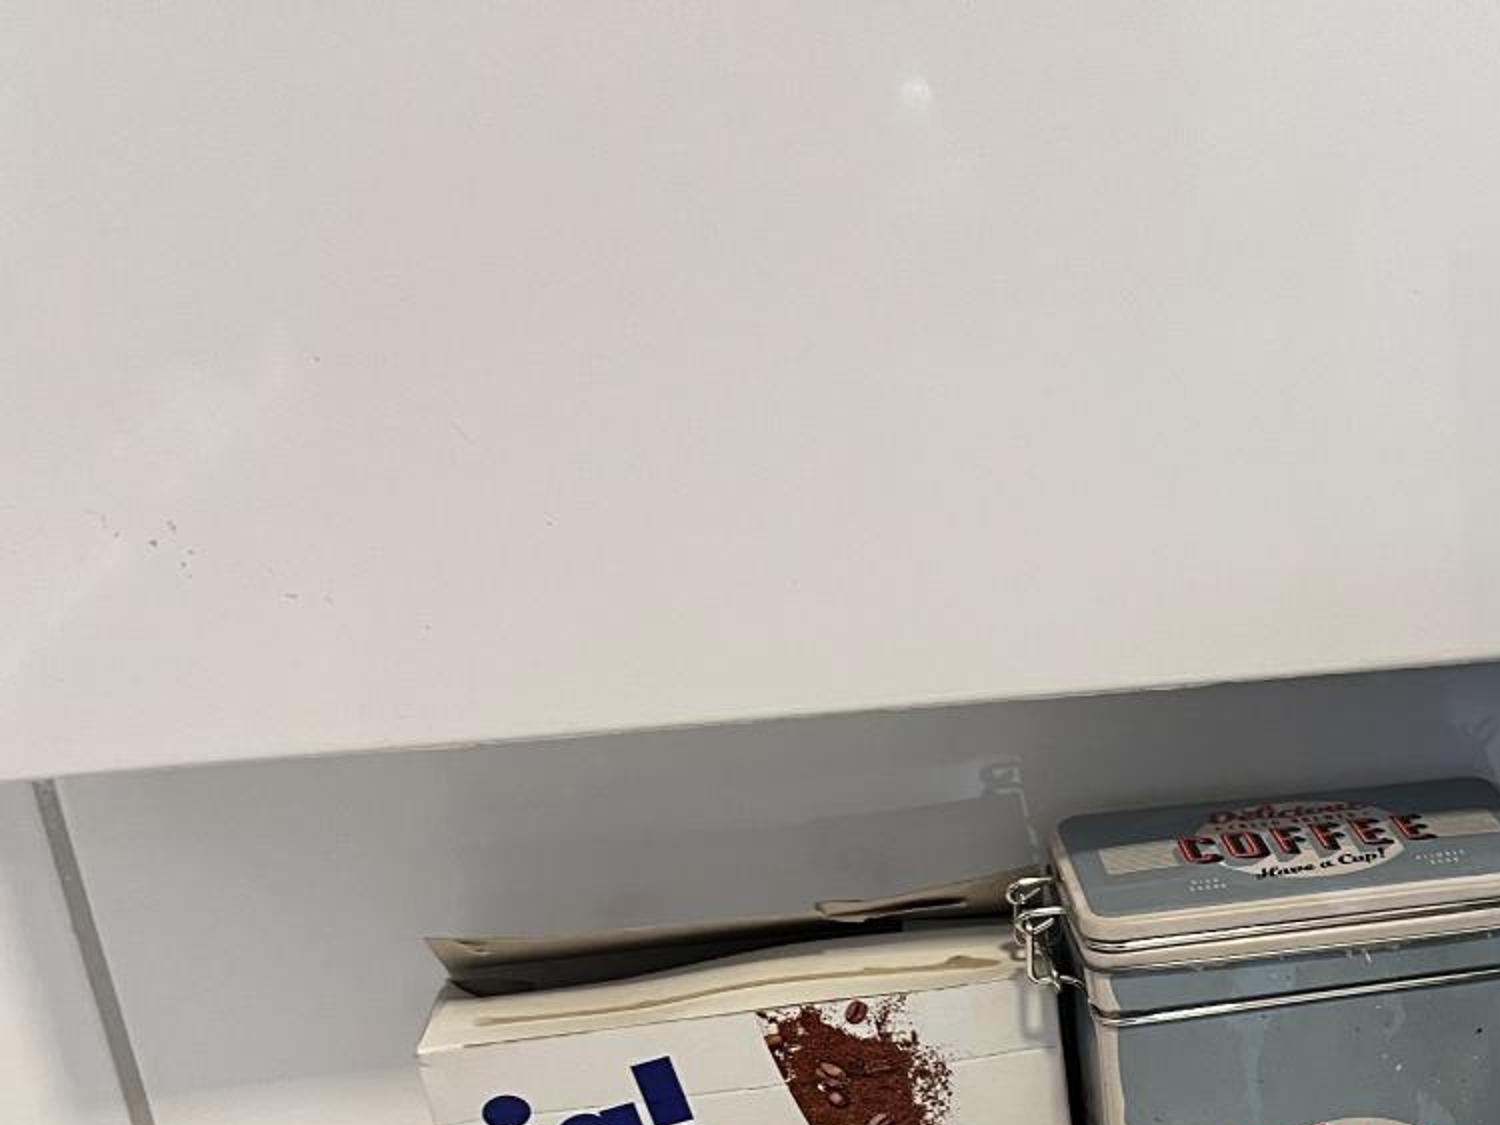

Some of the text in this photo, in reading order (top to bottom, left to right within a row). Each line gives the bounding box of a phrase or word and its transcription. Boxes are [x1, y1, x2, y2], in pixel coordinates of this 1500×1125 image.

[1177, 813, 1439, 865] COFFEE
[1255, 847, 1387, 881] Have a Cup!
